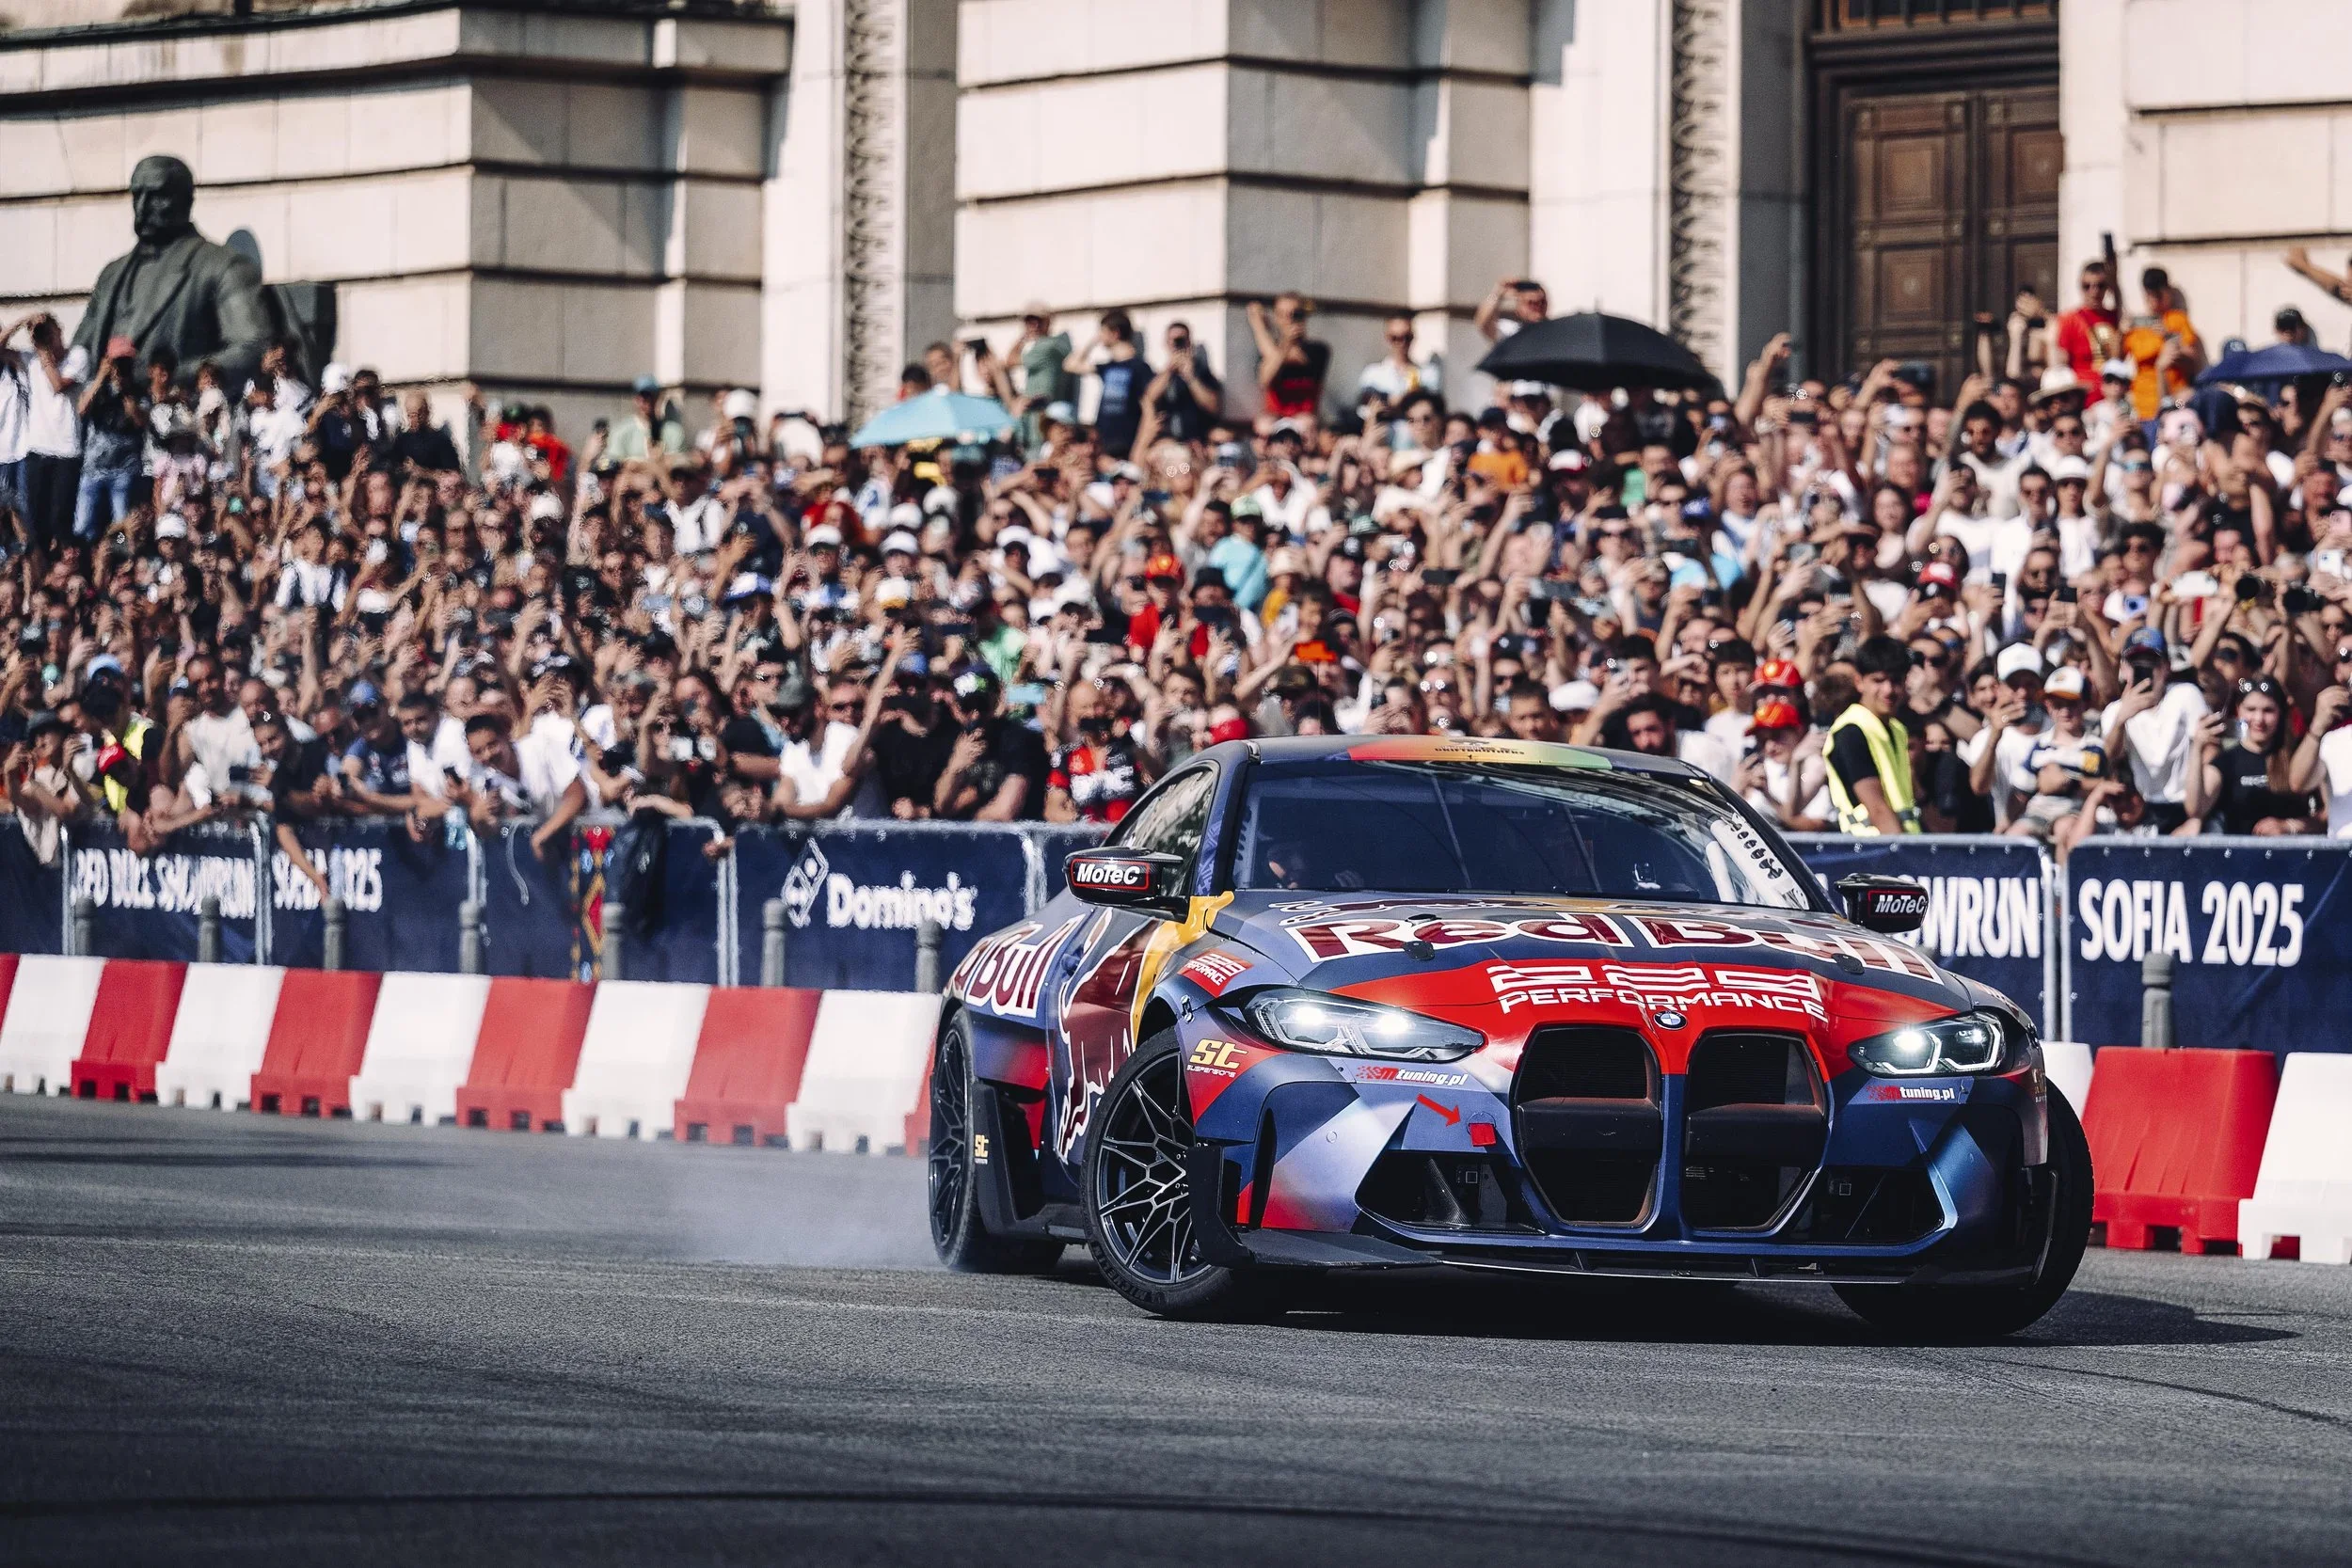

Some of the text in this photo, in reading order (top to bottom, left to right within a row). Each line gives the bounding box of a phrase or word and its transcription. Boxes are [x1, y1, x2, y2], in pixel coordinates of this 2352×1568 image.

[827, 870, 978, 931] Domino's
[1076, 863, 1140, 885] MoTeC
[1284, 911, 1945, 986] Red Bull
[2078, 878, 2304, 967] SOFIA 2025
[1498, 988, 1829, 1023] PERFORMANCE
